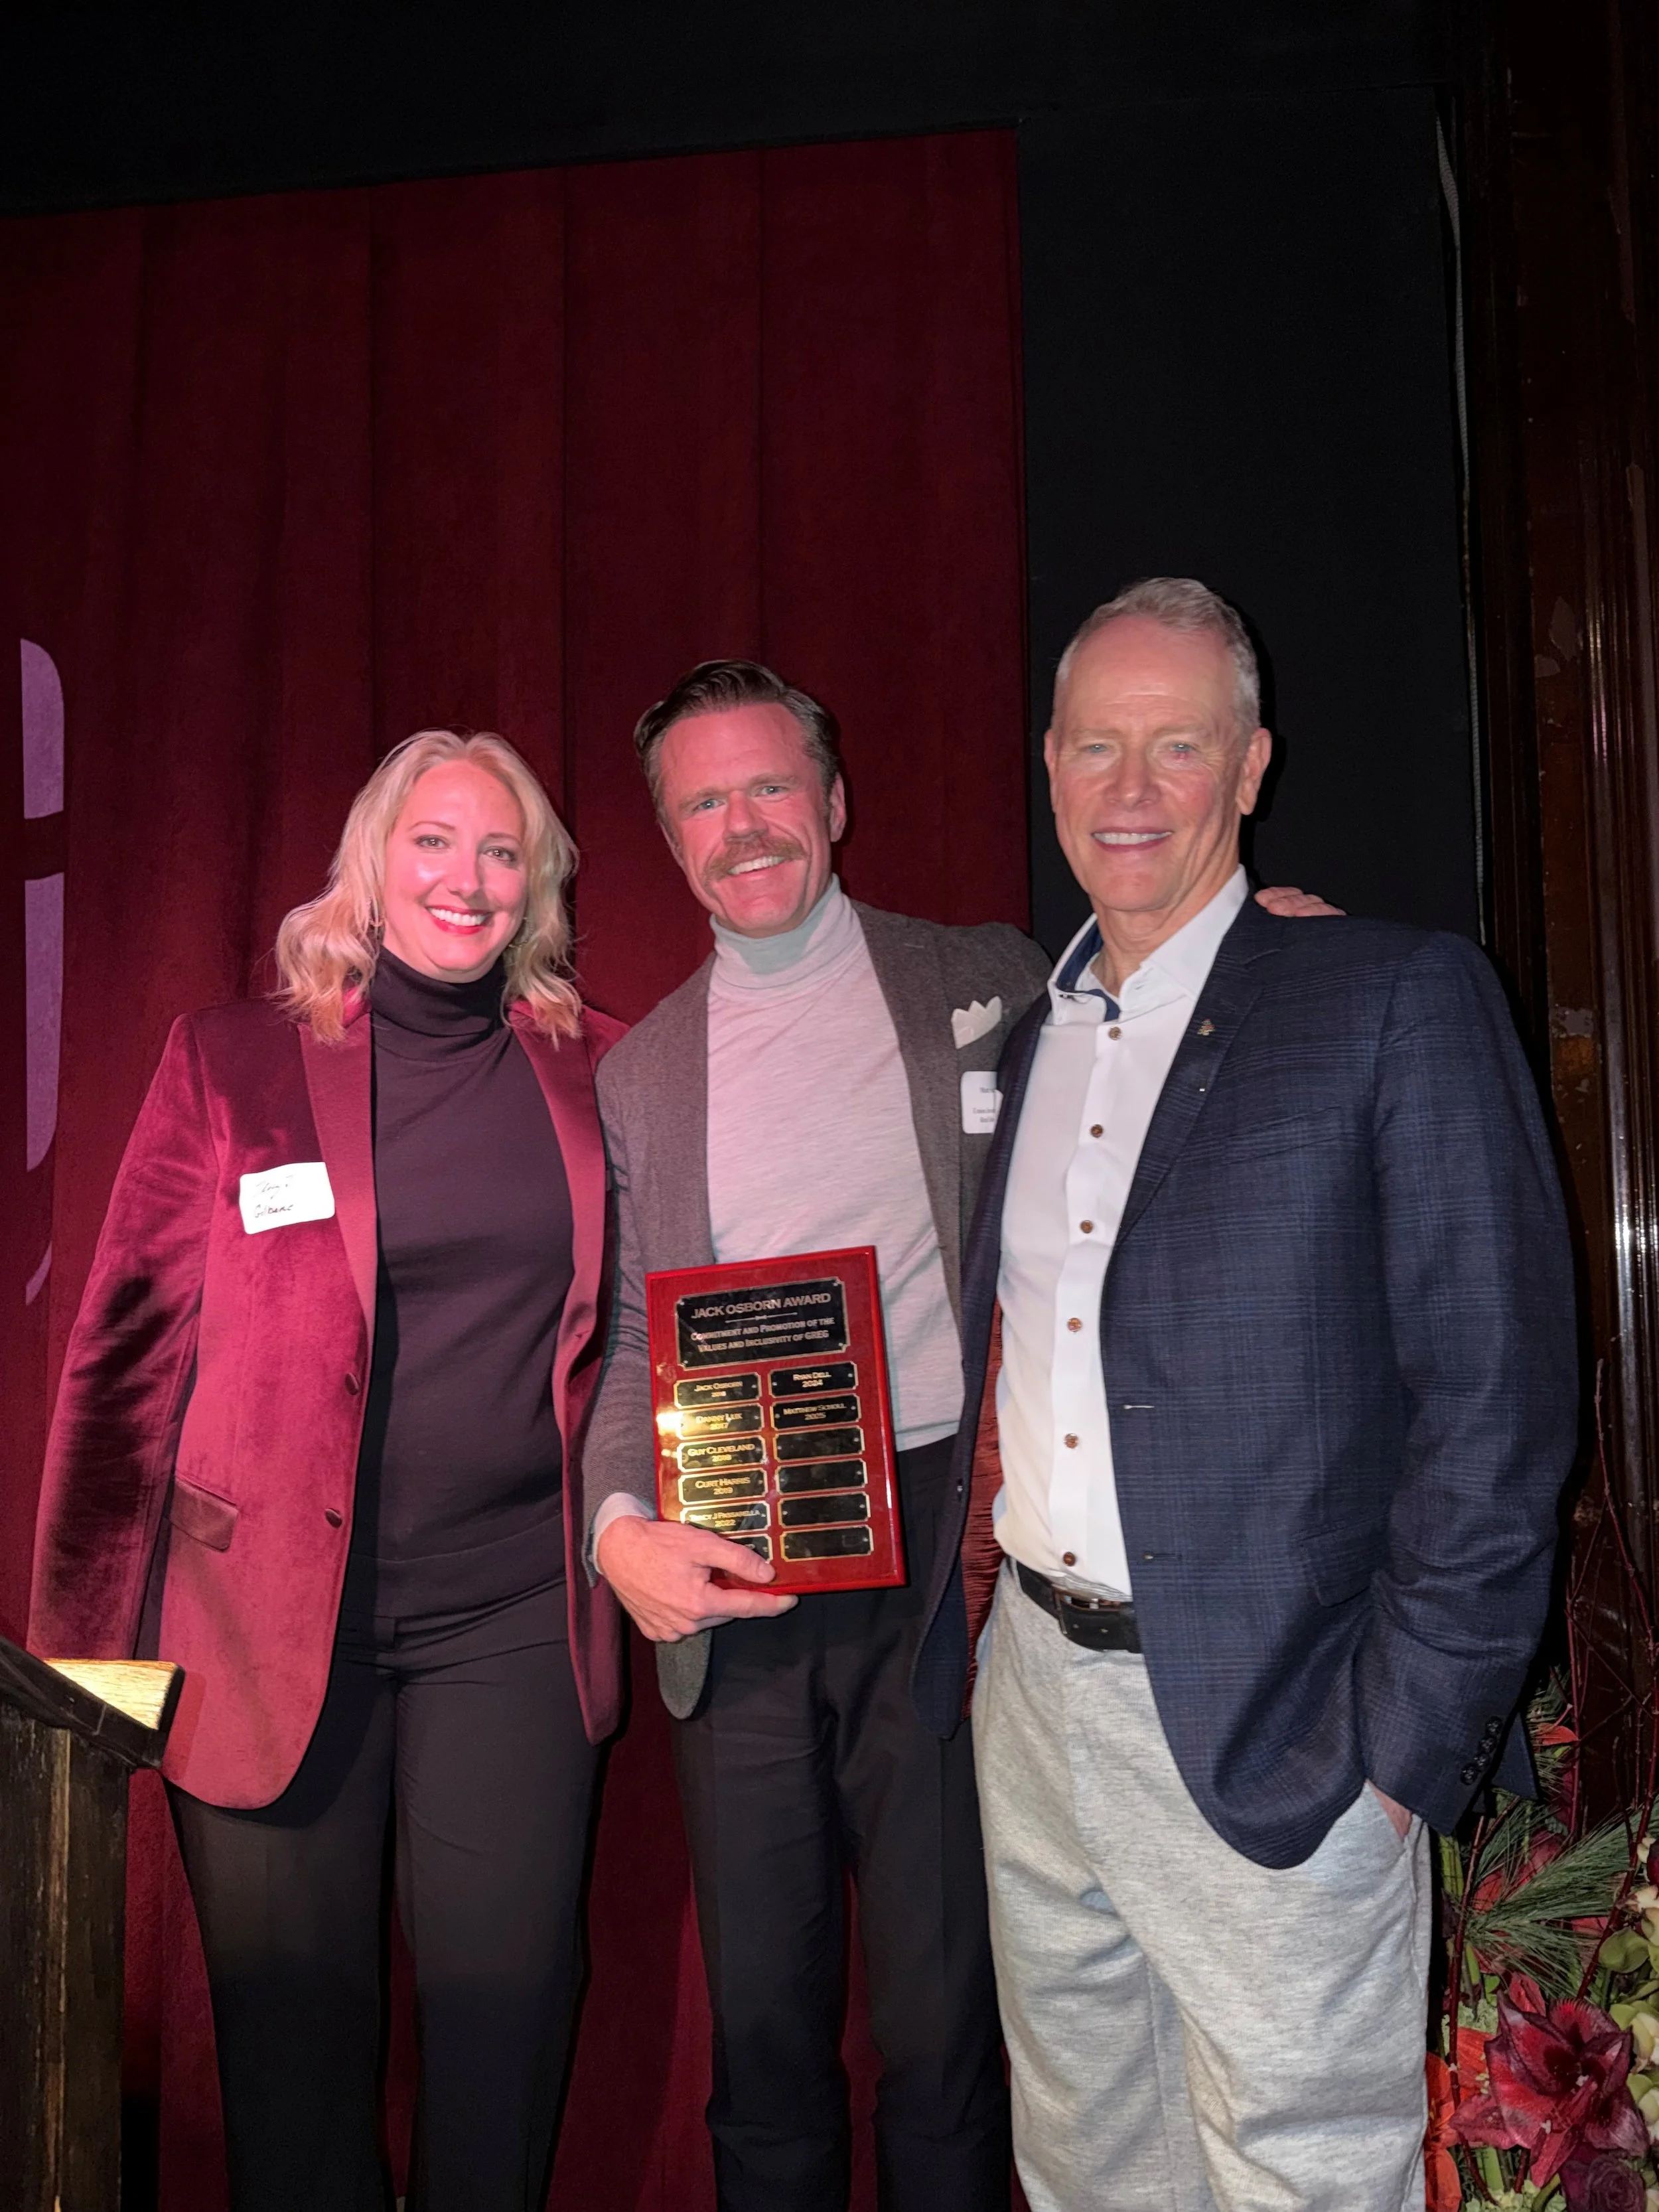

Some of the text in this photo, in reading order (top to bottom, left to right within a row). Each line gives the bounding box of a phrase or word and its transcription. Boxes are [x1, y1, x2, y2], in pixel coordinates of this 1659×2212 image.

[691, 1293, 831, 1319] JACK OSBORN AWARD
[743, 1327, 758, 1335] AND
[759, 1320, 806, 1333] PROMOTION
[697, 1343, 727, 1353] VALUES
[728, 1340, 744, 1349] AND
[793, 1333, 804, 1341] OF
[805, 1330, 829, 1339] GREG
[706, 1443, 755, 1454] CLEVELAND
